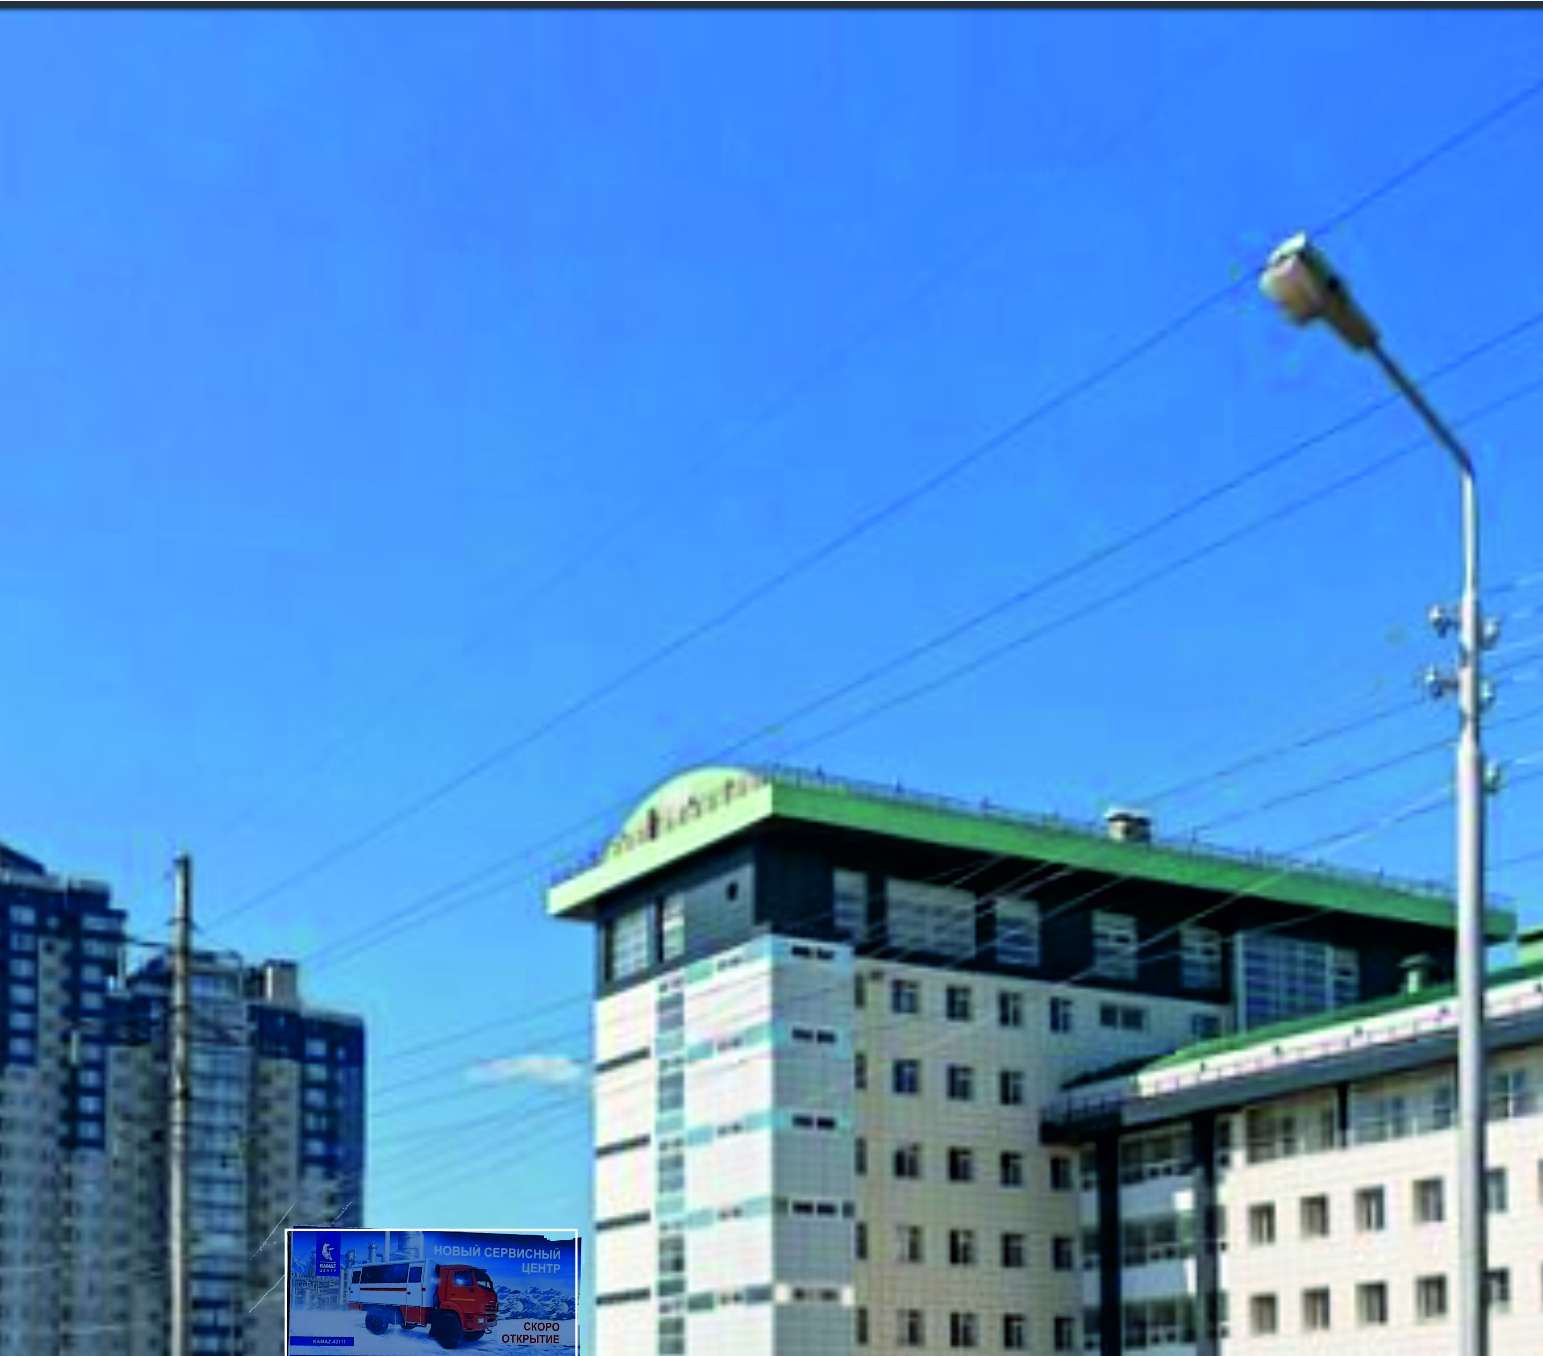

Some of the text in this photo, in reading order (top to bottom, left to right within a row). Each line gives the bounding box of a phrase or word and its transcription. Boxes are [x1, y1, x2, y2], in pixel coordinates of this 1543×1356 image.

[434, 1244, 561, 1260] НОВЫЙ СЕРВИСНЫЙ
[522, 1262, 561, 1275] ЦЕНТР
[523, 1322, 560, 1332] СКОРО
[501, 1334, 560, 1344] ОТКРЫТИЕ
